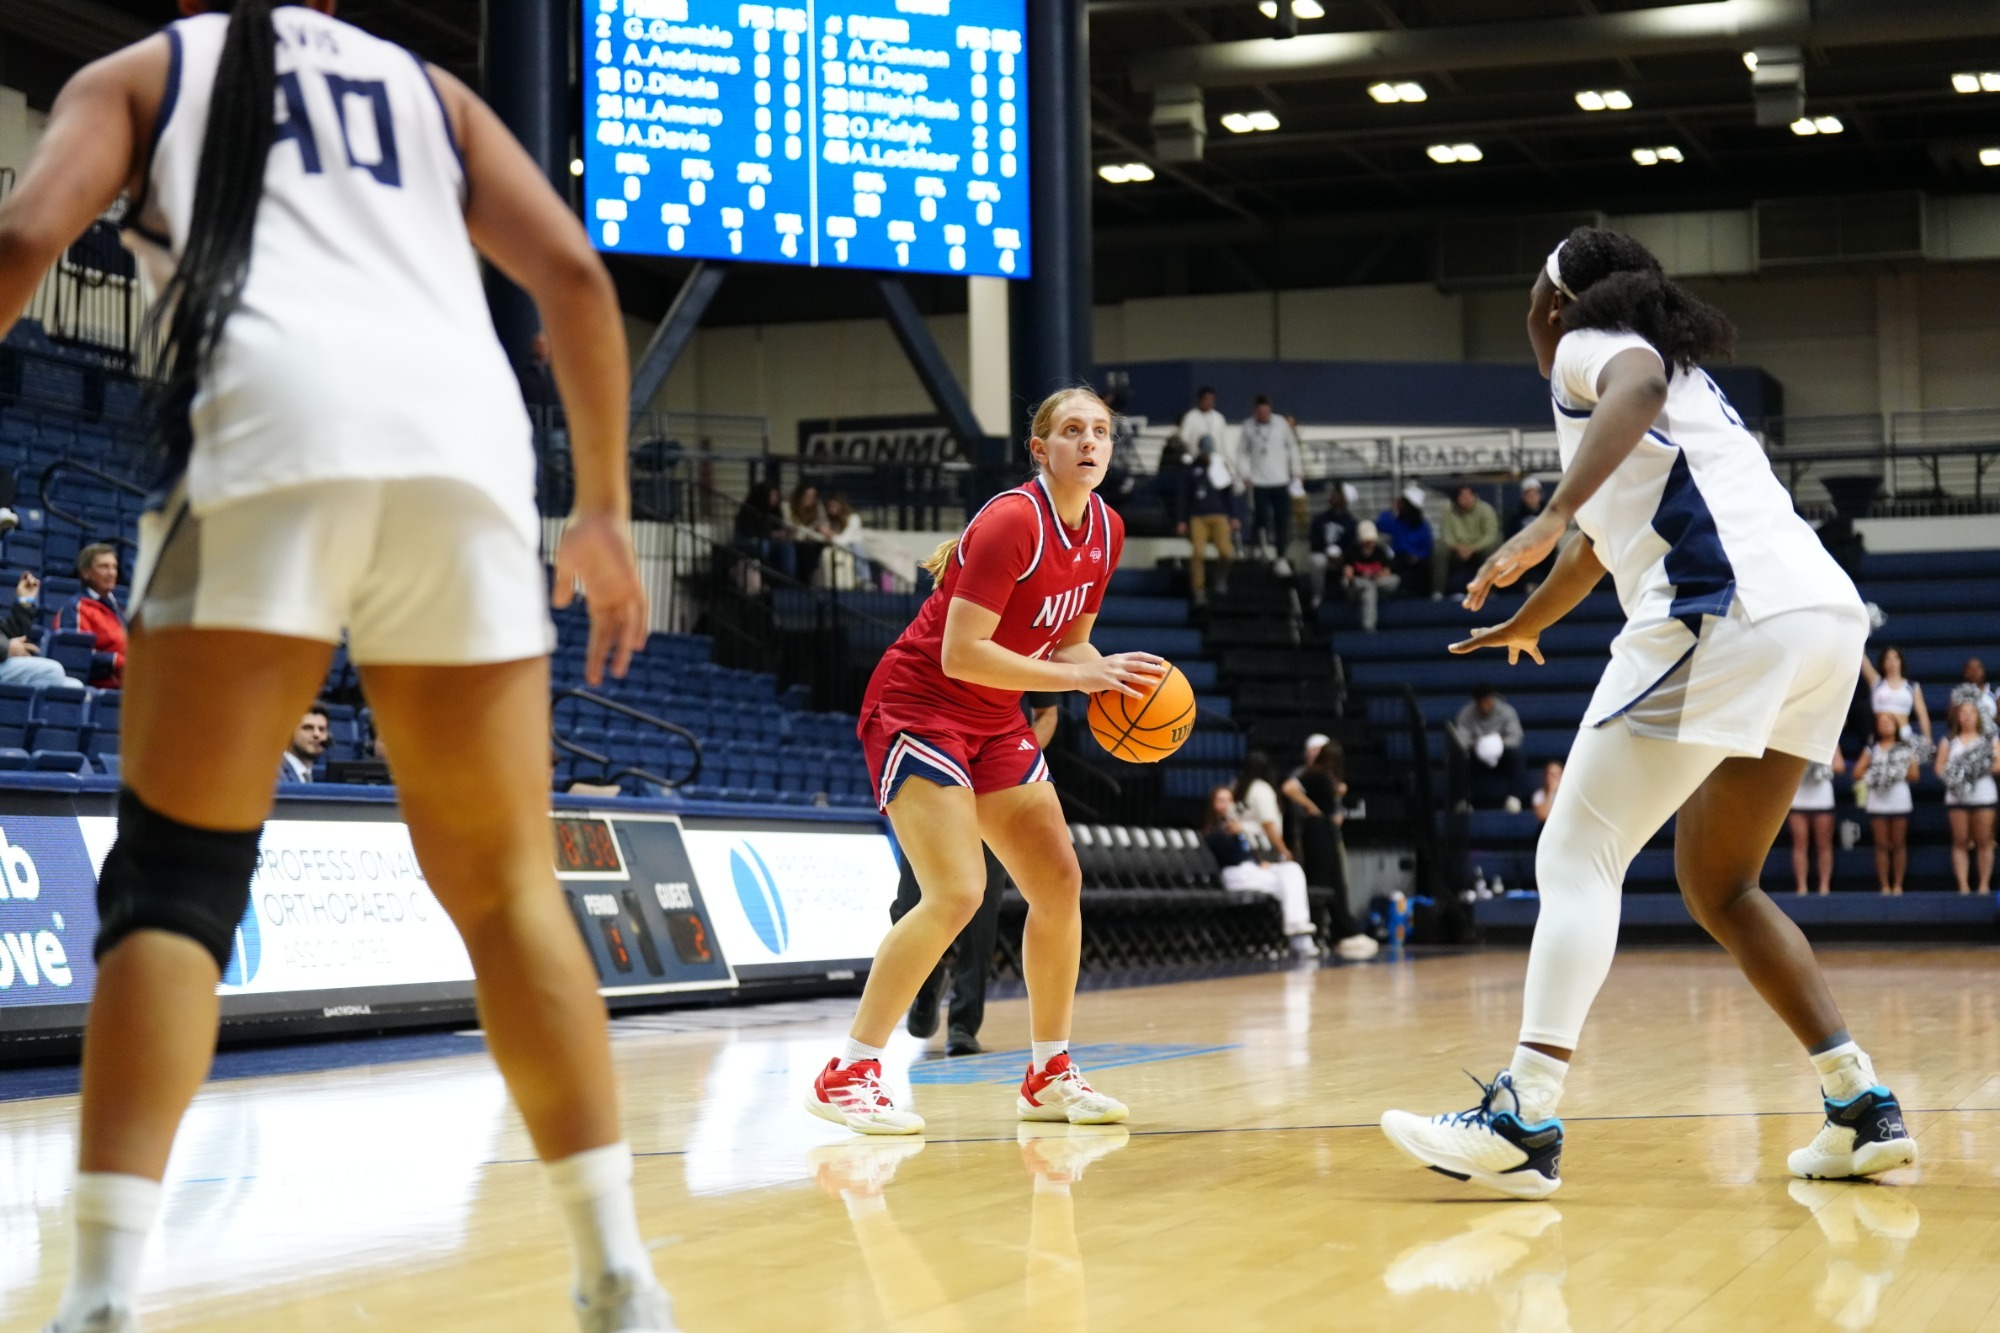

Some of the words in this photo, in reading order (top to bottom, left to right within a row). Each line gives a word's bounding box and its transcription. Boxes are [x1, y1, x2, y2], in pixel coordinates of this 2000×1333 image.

[1030, 581, 1095, 637] NJIT
[256, 849, 425, 881] PROFESSIONAL
[263, 892, 427, 926] ORTHOPAEDIC
[655, 882, 693, 909] GUEST
[284, 937, 393, 968] ASSOCATES
[611, 928, 628, 963] 1
[689, 916, 710, 959] 2
